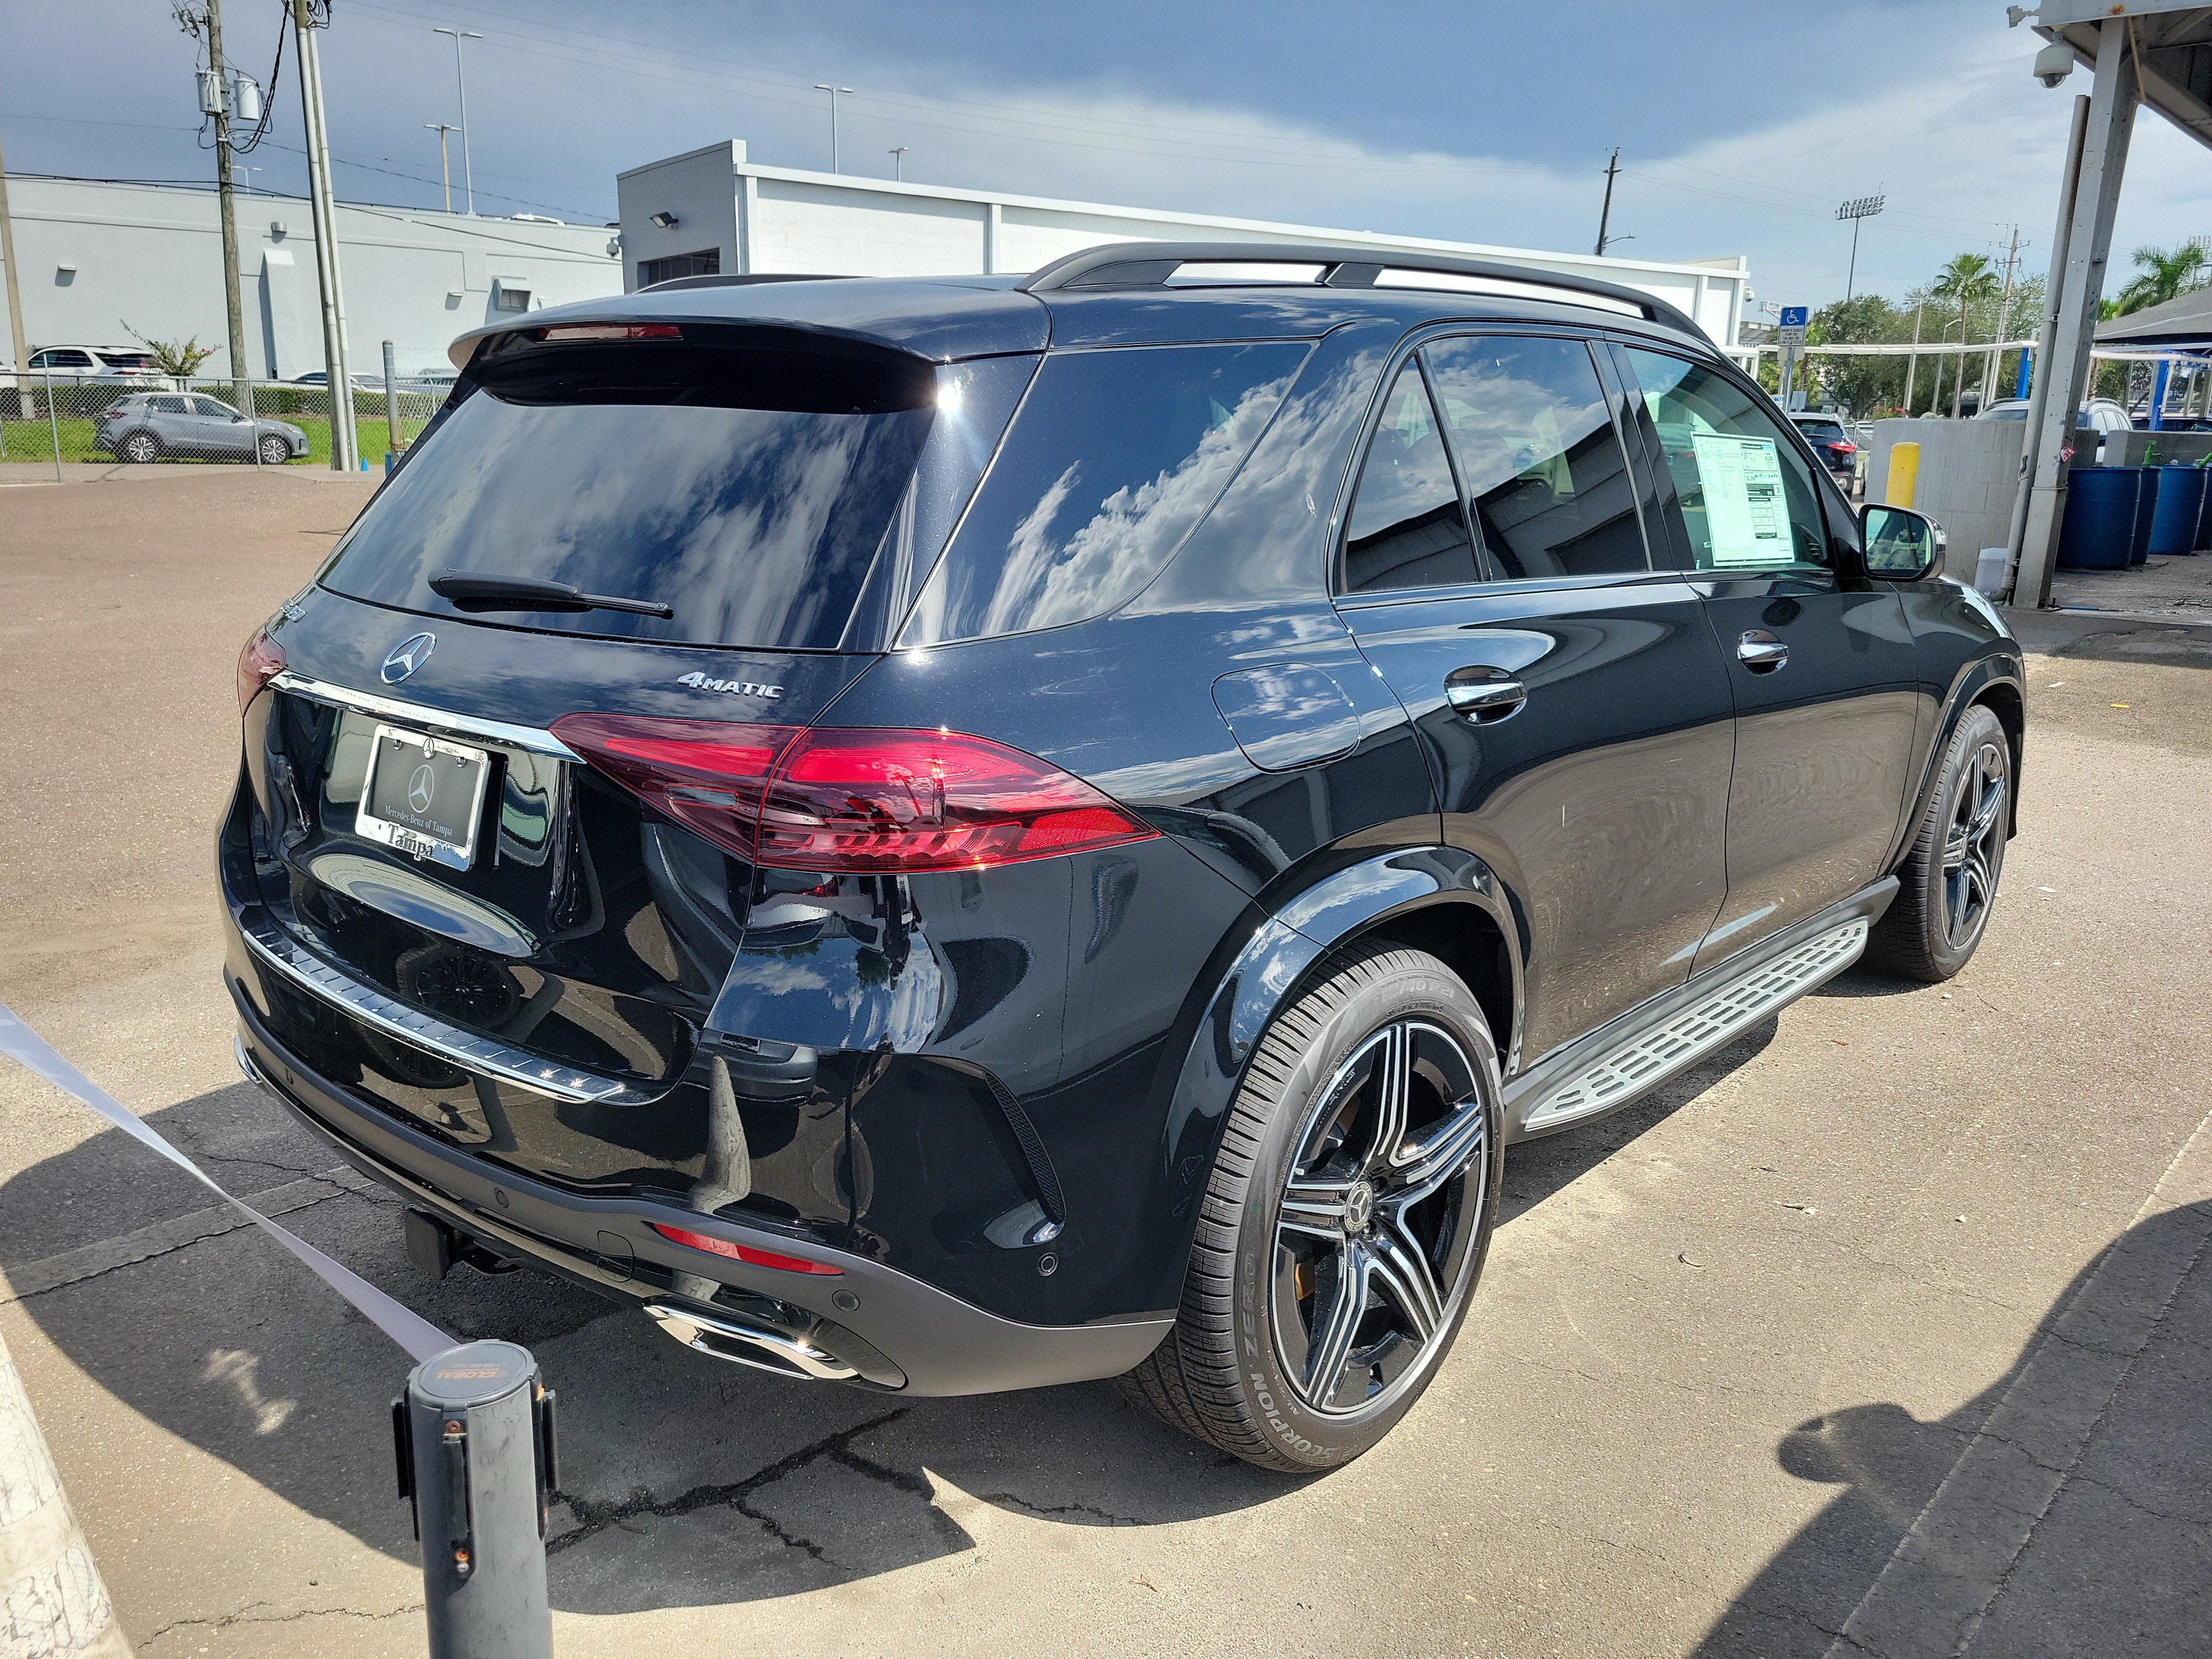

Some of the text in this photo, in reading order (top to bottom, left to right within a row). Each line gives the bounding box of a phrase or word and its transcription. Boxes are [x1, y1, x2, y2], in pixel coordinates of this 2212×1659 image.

[676, 672, 784, 699] 4MATIC
[385, 805, 453, 837] Mercedes-Benz of Tampa
[388, 823, 434, 860] Tampa
[1243, 1254, 1339, 1458] SCORPION ZERO
